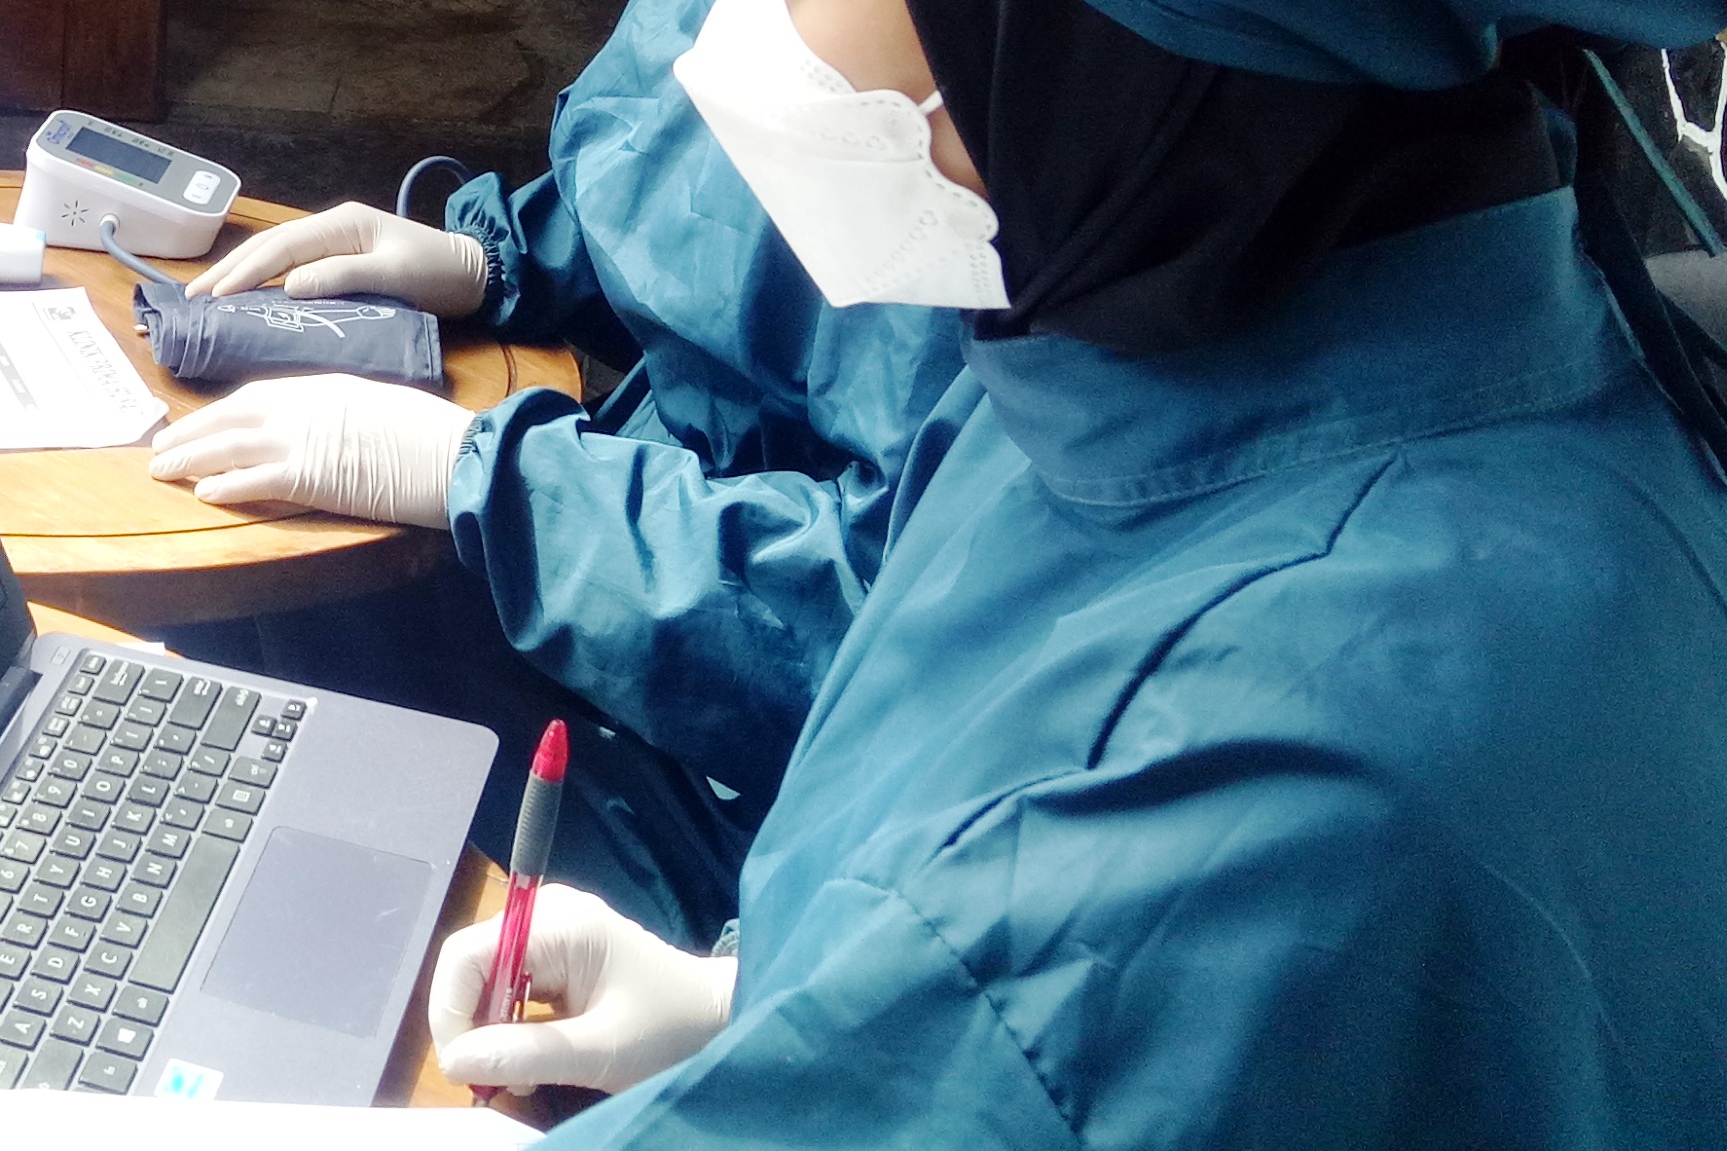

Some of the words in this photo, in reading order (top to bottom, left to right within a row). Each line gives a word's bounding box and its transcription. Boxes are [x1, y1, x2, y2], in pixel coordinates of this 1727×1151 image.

[0, 869, 14, 879] 6
[15, 840, 29, 850] 7
[32, 813, 46, 822] 8
[48, 786, 61, 795] 9
[0, 954, 15, 964] E
[16, 924, 32, 933] R
[33, 894, 48, 902] T
[50, 864, 64, 873] Y
[65, 835, 80, 846] U
[111, 756, 123, 765] P
[15, 1023, 31, 1034] A
[31, 989, 47, 1000] S
[48, 957, 63, 968] D
[65, 927, 79, 937] F
[81, 896, 96, 907] G
[96, 866, 112, 878] H
[113, 839, 126, 848] J
[126, 811, 141, 821] K
[141, 786, 156, 794] L
[67, 1017, 84, 1029] Z
[85, 984, 101, 996] X
[101, 952, 117, 963] C
[116, 921, 131, 932] V
[132, 893, 147, 903] B
[147, 862, 163, 875] N
[162, 833, 177, 847] M
